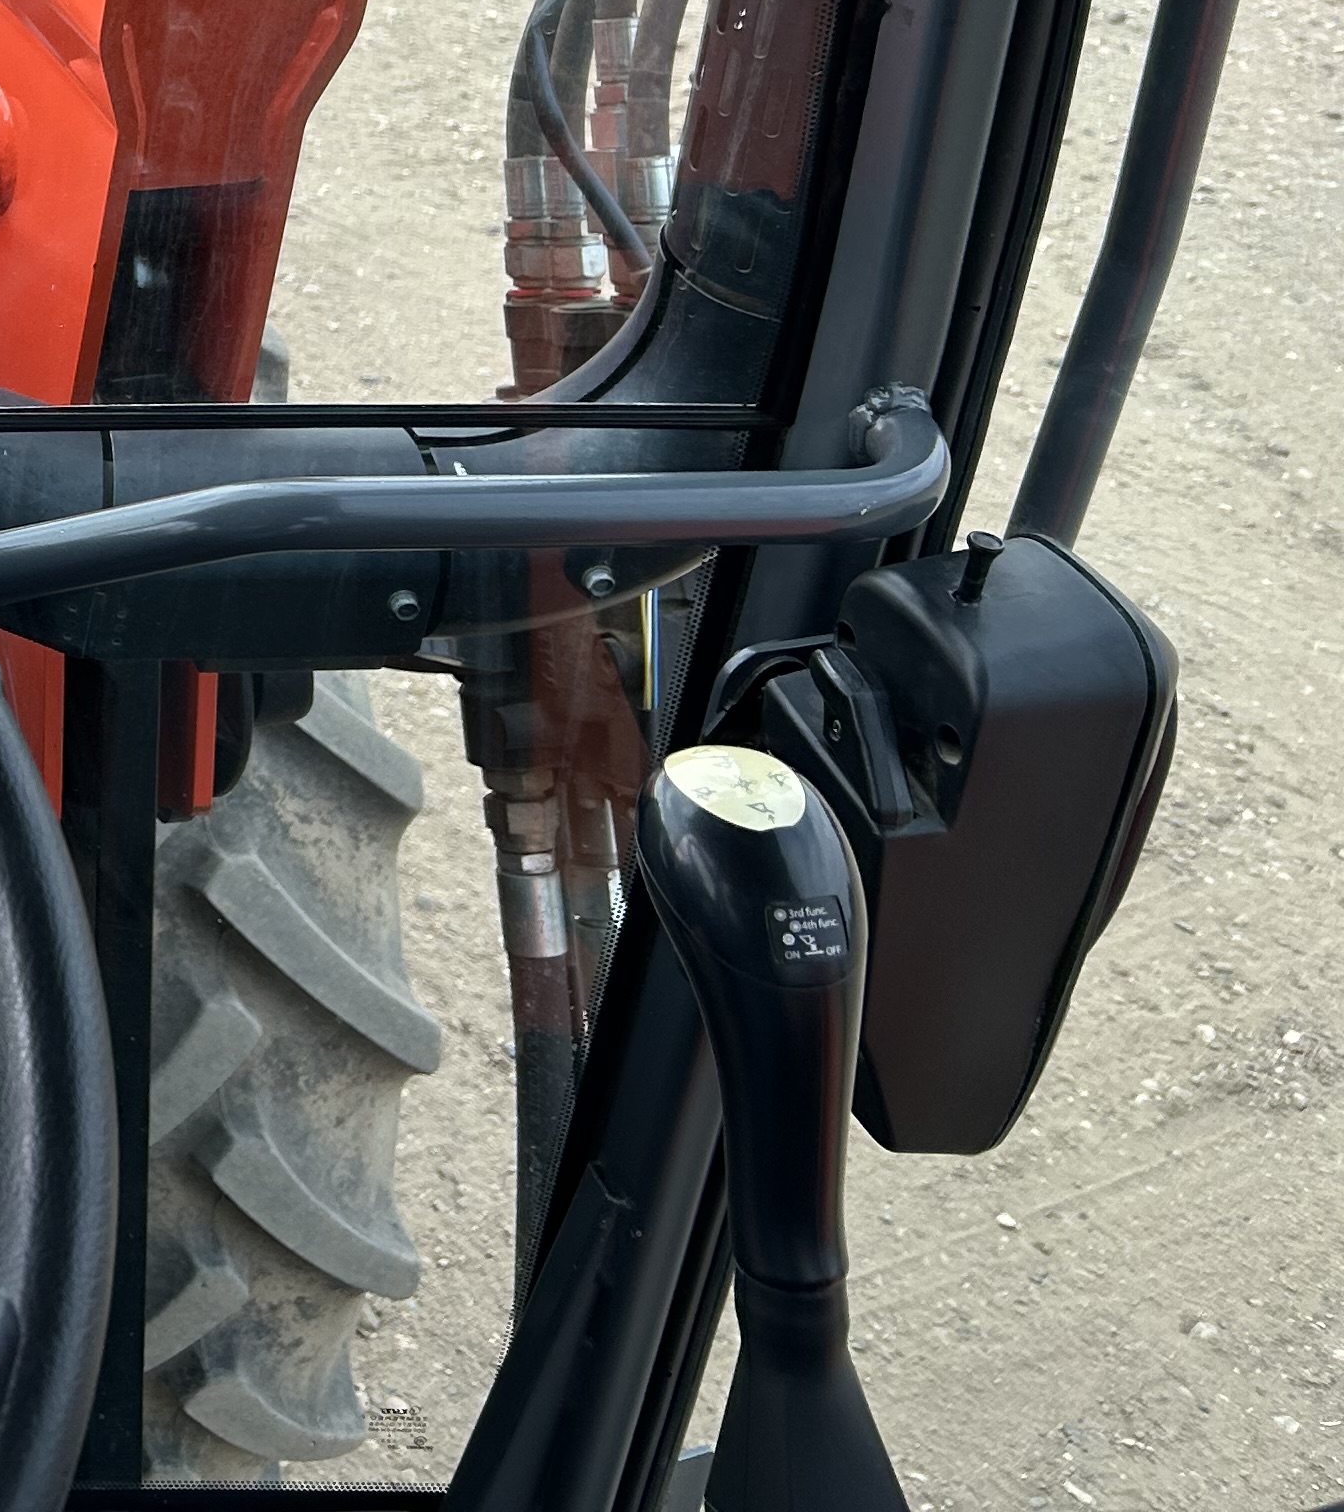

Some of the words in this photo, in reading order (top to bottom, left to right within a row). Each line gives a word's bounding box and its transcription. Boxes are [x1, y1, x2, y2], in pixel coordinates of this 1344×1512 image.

[788, 908, 805, 919] 3rd
[784, 950, 801, 960] ON
[825, 944, 842, 956] OFF
